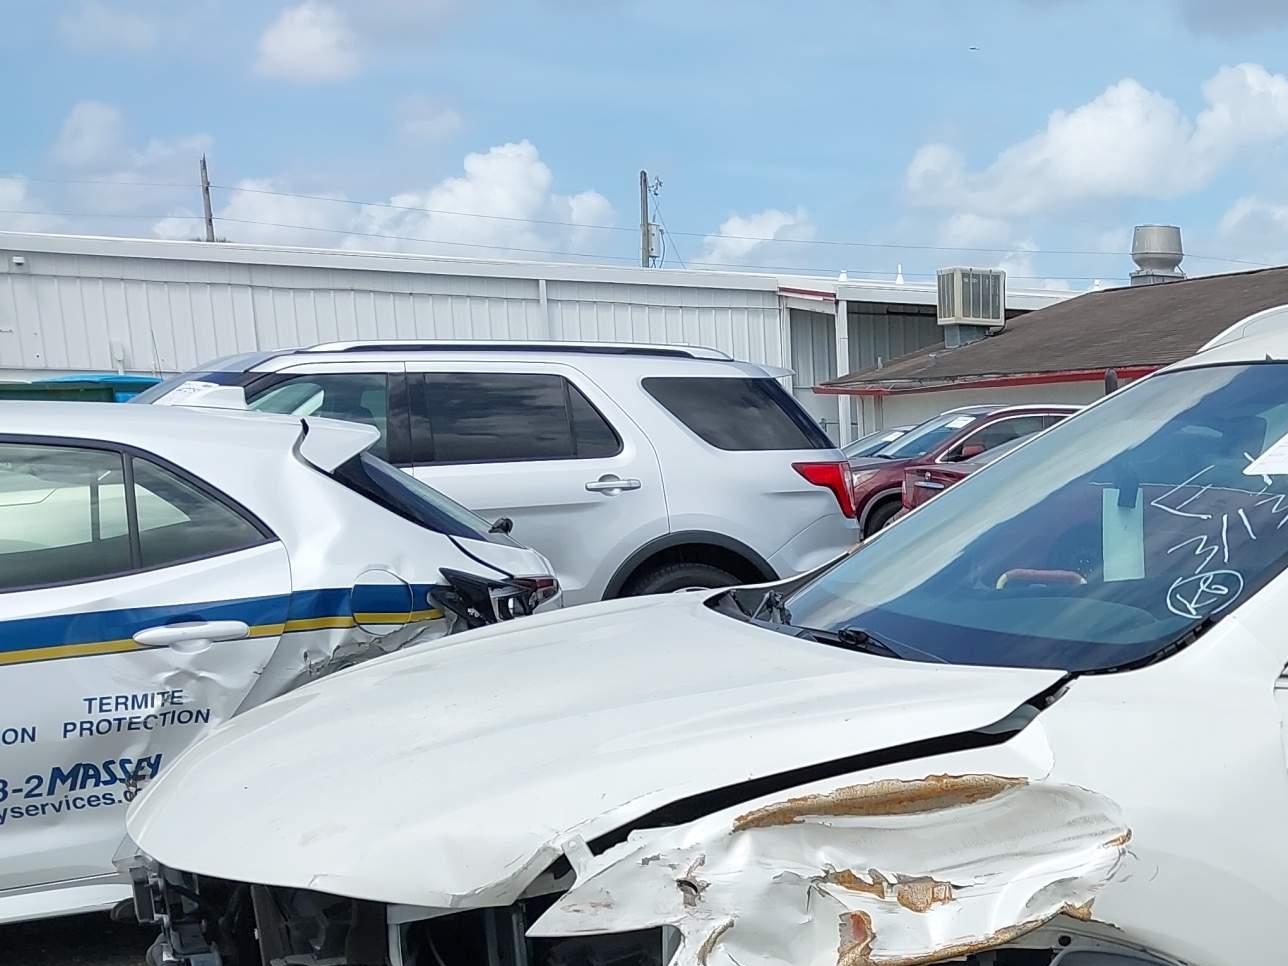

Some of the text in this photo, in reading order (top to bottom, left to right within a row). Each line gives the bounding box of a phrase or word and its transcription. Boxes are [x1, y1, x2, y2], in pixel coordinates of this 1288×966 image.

[83, 689, 184, 714] TERMITE
[1, 726, 36, 745] ON
[62, 708, 211, 738] PROTECTION
